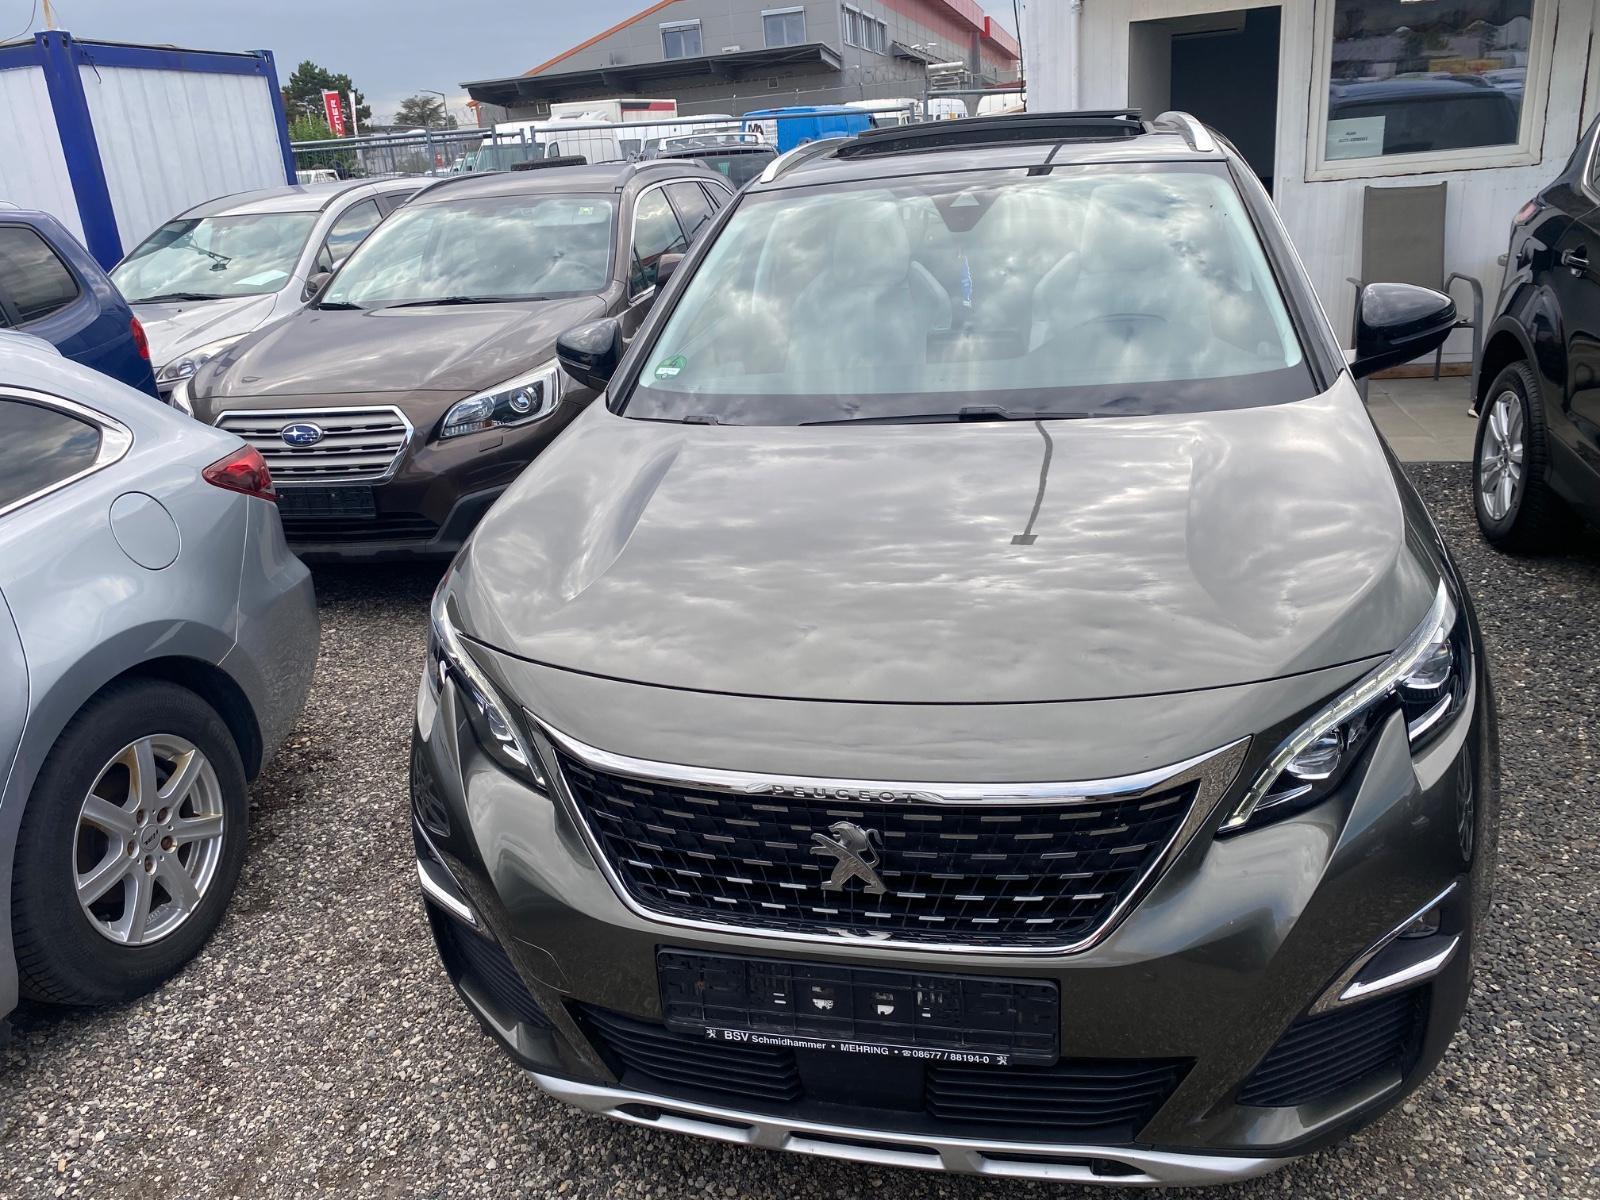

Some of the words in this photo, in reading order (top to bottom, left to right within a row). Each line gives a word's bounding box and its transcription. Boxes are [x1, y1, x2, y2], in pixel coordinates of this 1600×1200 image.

[771, 784, 917, 804] PEUGEOT
[724, 1030, 749, 1042] BSV
[751, 1034, 827, 1050] Schmidhammer
[840, 1043, 889, 1055] MEHRING
[950, 1053, 990, 1064] 88194-0
